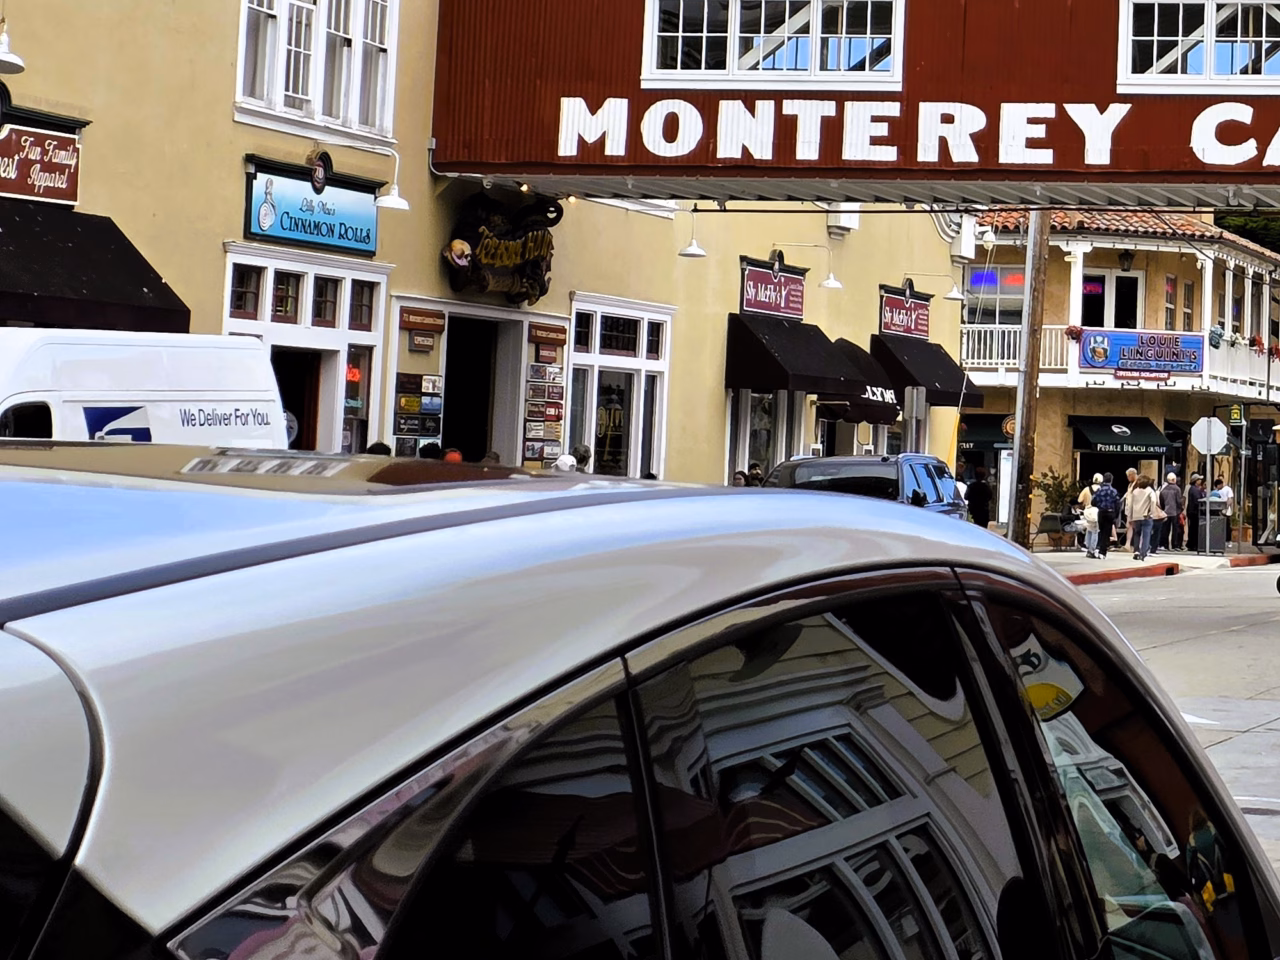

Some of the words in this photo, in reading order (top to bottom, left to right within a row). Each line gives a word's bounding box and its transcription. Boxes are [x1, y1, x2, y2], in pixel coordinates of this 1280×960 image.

[558, 98, 1132, 164] MONTEREY
[20, 136, 41, 160] Fun
[44, 140, 77, 173] Family
[28, 164, 68, 194] Apparel
[280, 211, 335, 239] CINNAMON
[338, 222, 371, 245] ROLLS
[1139, 334, 1181, 348] LOUIE
[179, 408, 197, 427] We
[198, 408, 232, 427] Deliver
[233, 408, 250, 426] For
